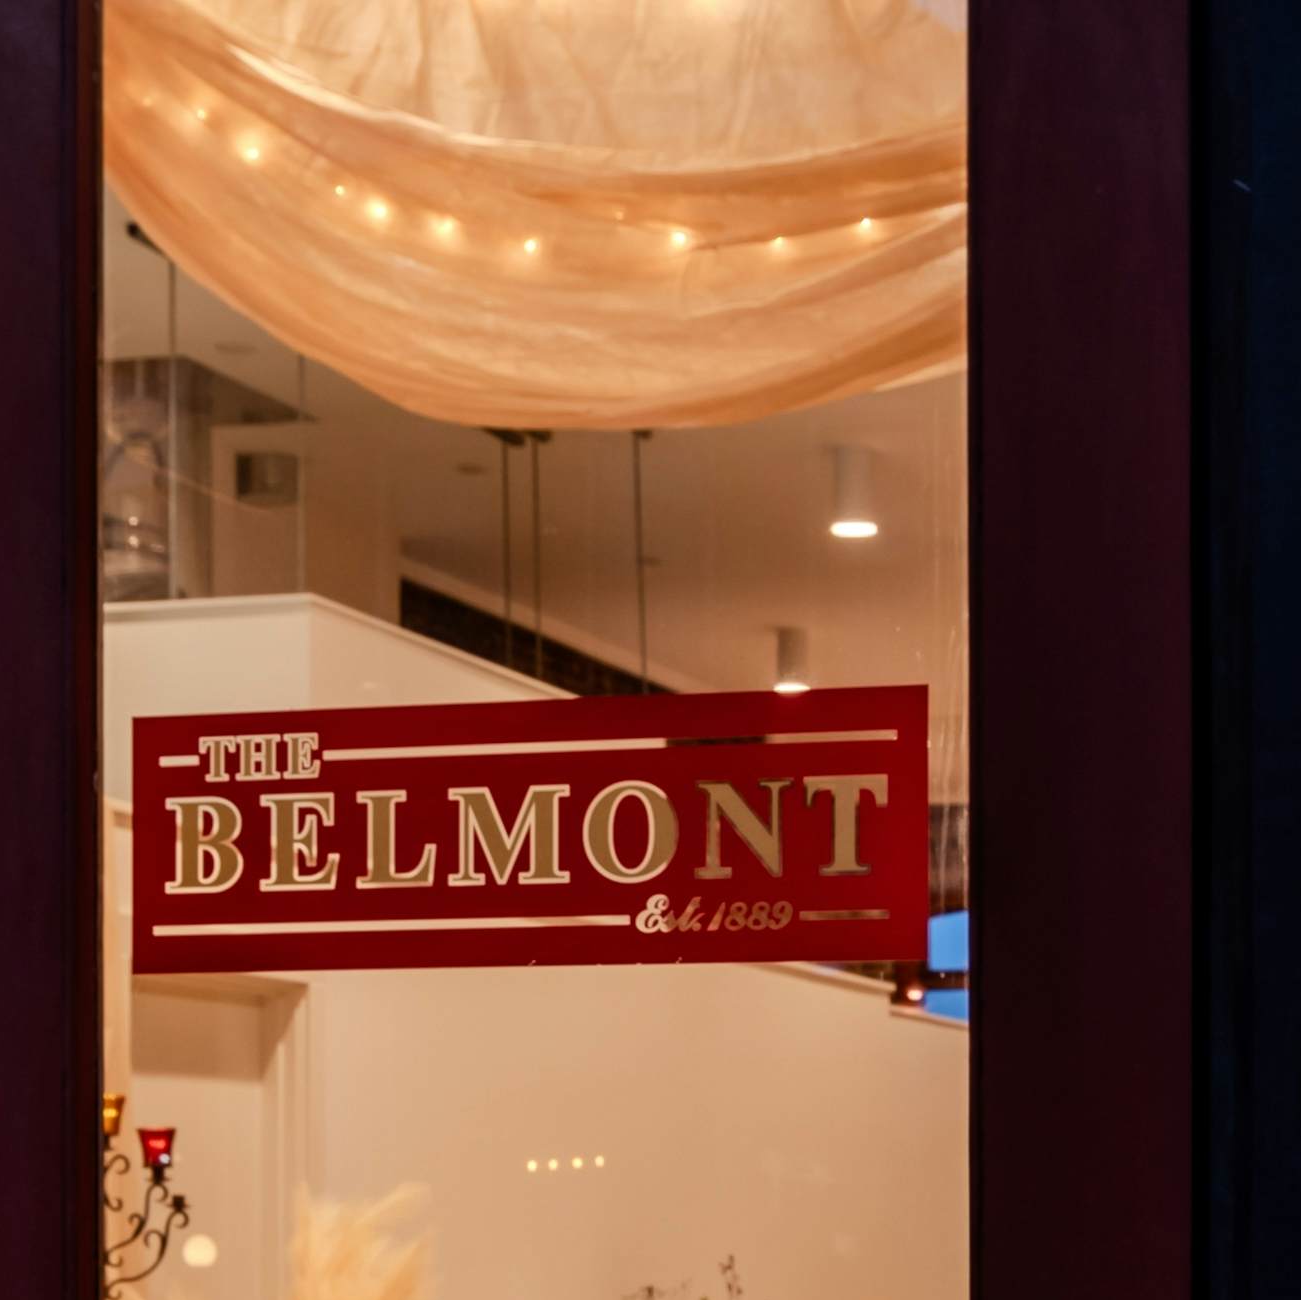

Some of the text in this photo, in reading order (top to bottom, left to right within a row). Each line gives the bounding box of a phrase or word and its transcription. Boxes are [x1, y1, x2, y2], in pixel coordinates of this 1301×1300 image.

[198, 732, 321, 782] THE
[164, 773, 889, 895] BELMONT
[706, 900, 794, 931] 1889
